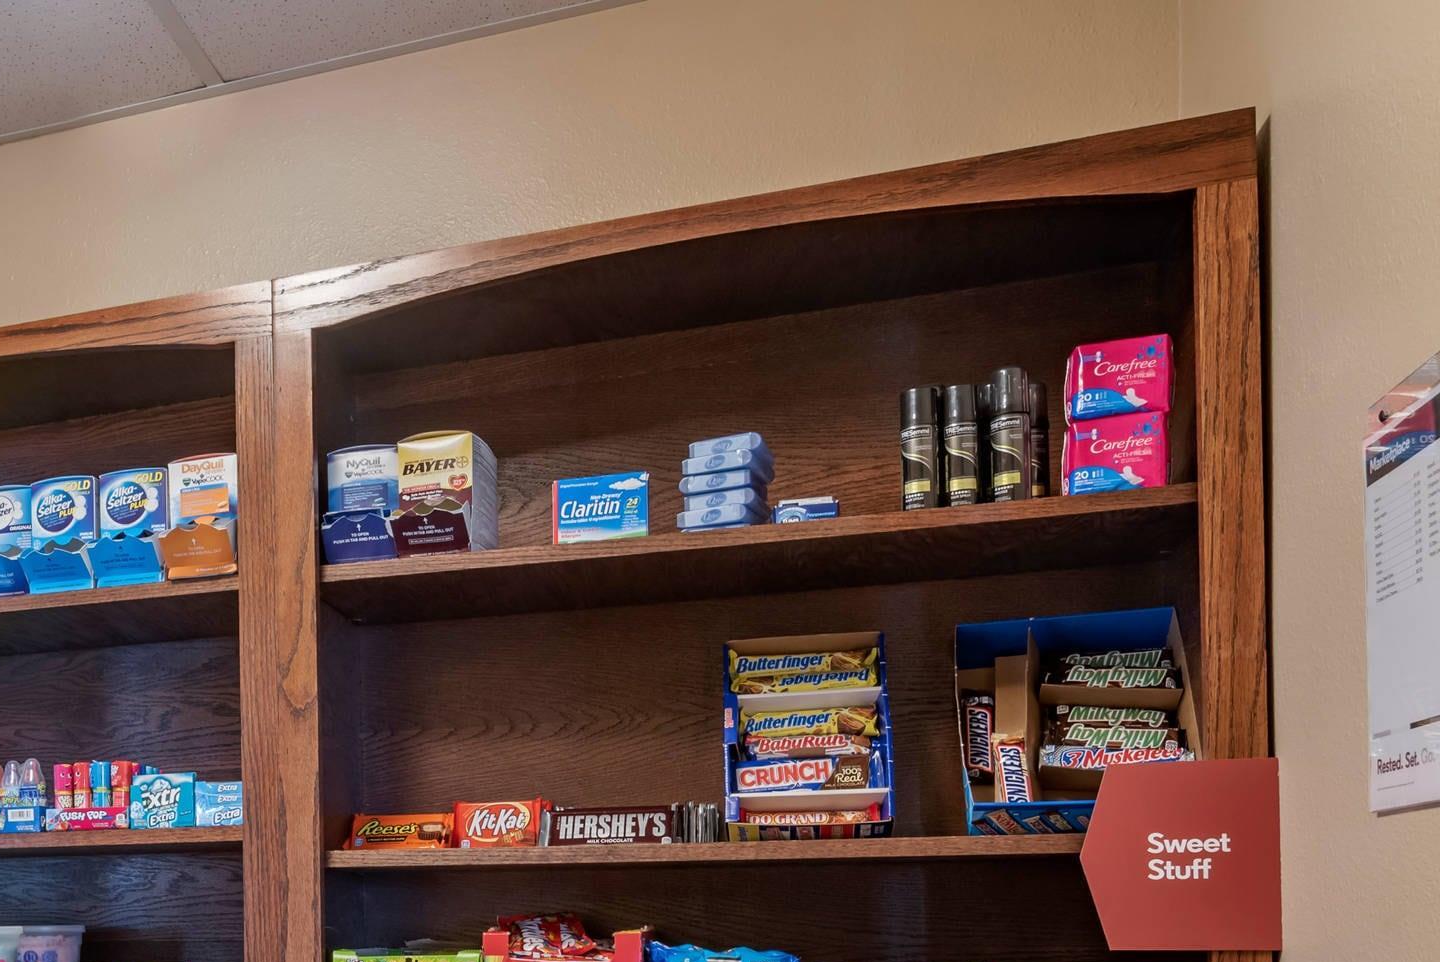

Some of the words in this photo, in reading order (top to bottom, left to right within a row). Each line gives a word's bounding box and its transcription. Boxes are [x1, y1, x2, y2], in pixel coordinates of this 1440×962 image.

[1094, 359, 1158, 376] Carefree
[1090, 436, 1153, 454] Carefree
[181, 458, 225, 475] DayQuil
[346, 457, 381, 469] NyQuil
[402, 458, 457, 476] BAYER
[135, 471, 163, 484] GOLD
[1074, 471, 1089, 480] 20
[64, 479, 91, 492] GOLD
[110, 485, 138, 500] Alka-
[37, 499, 73, 518] Seltzer
[42, 494, 67, 507] Alka-
[107, 491, 144, 511] Seltzer
[560, 499, 620, 519] Claritin
[736, 653, 826, 674] Butterfinger
[779, 669, 870, 686] Butterfinger
[745, 712, 833, 733] Butterfinger
[967, 708, 990, 767] SNICKERS
[1062, 748, 1086, 769] 3
[739, 760, 831, 788] CRUNCH
[835, 773, 864, 784] Real
[998, 746, 1030, 804] SNICKERS
[217, 784, 238, 792] Extra
[59, 811, 86, 821] PUSH
[87, 811, 107, 820] POP
[149, 812, 176, 827] Extra
[214, 808, 241, 824] Extra
[774, 812, 830, 825] GRAND
[357, 819, 418, 836] Reese's
[559, 813, 667, 840] HERSHEY'S
[1146, 832, 1231, 853] Sweet
[1146, 858, 1212, 880] Stuff
